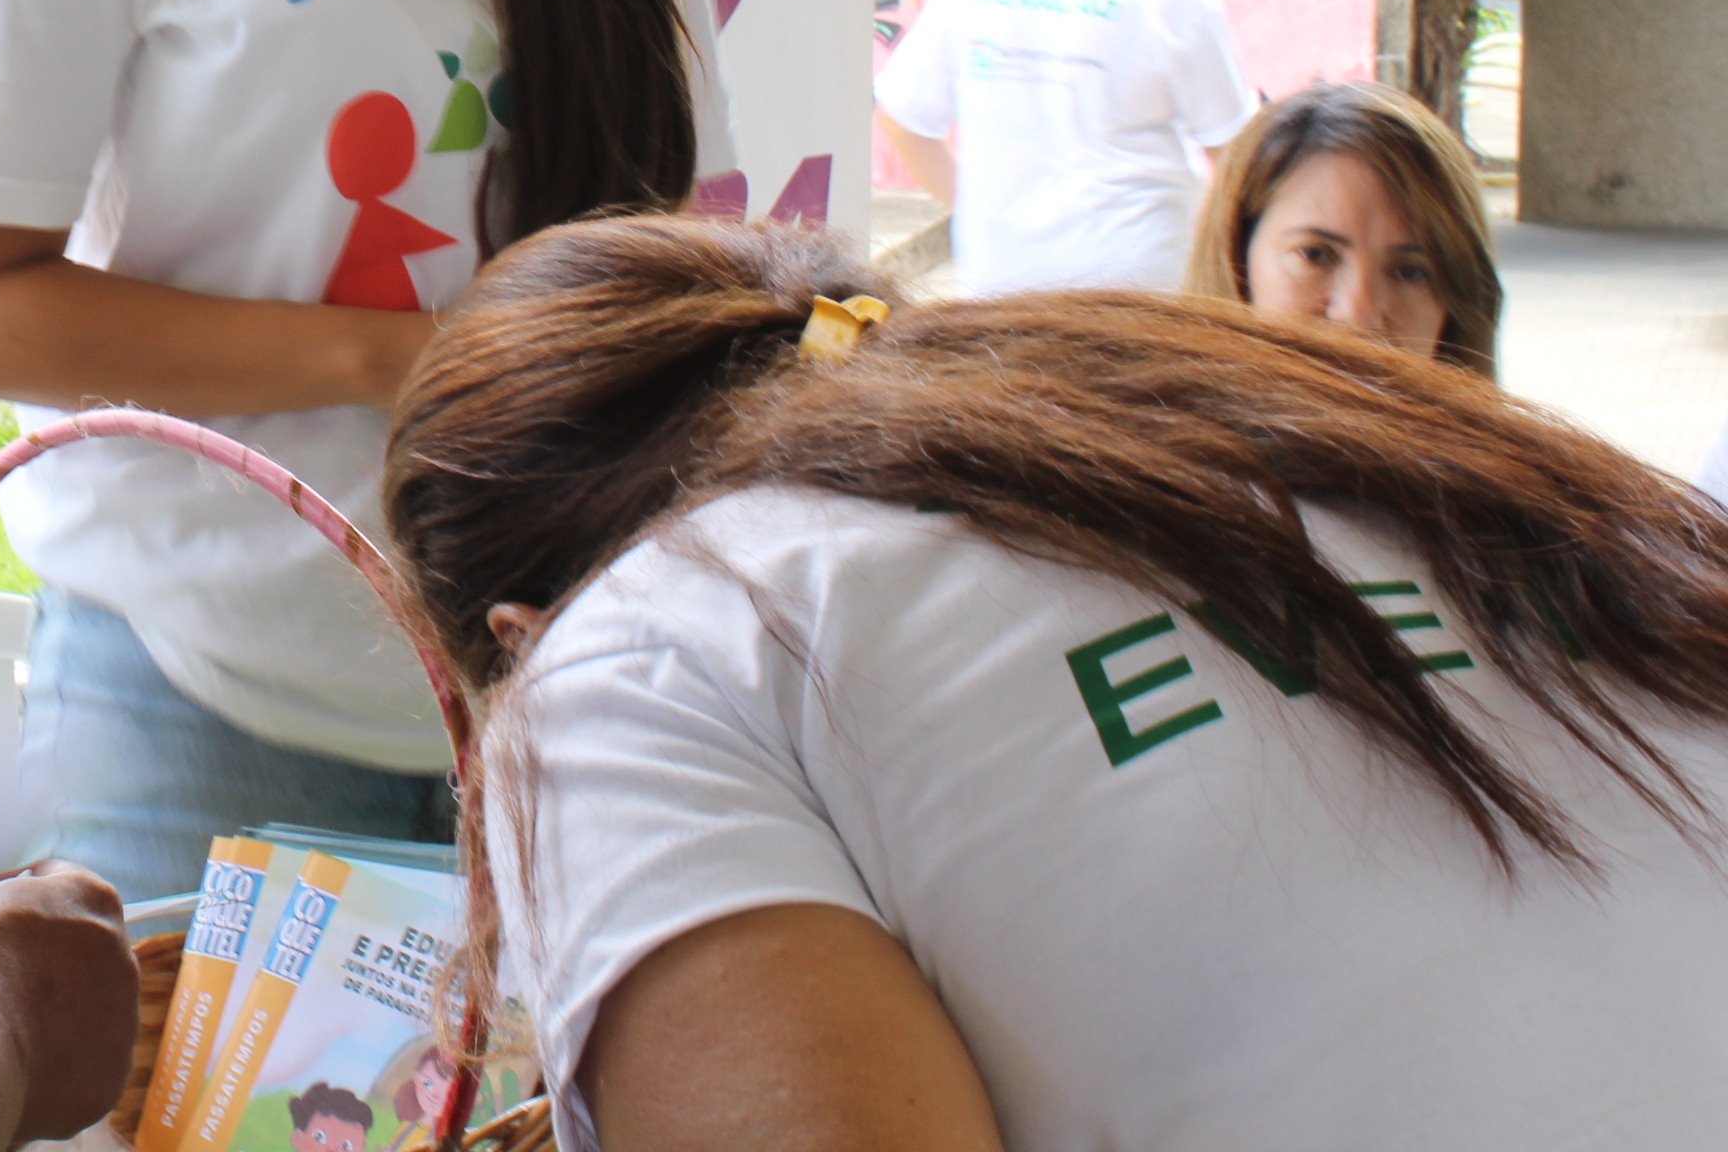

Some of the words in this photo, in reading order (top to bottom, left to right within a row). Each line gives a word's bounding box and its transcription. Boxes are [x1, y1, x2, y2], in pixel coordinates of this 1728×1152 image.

[352, 933, 372, 958] E
[160, 991, 214, 1129] PASSATEMPOS
[198, 1008, 270, 1143] PASSATEMPOS
